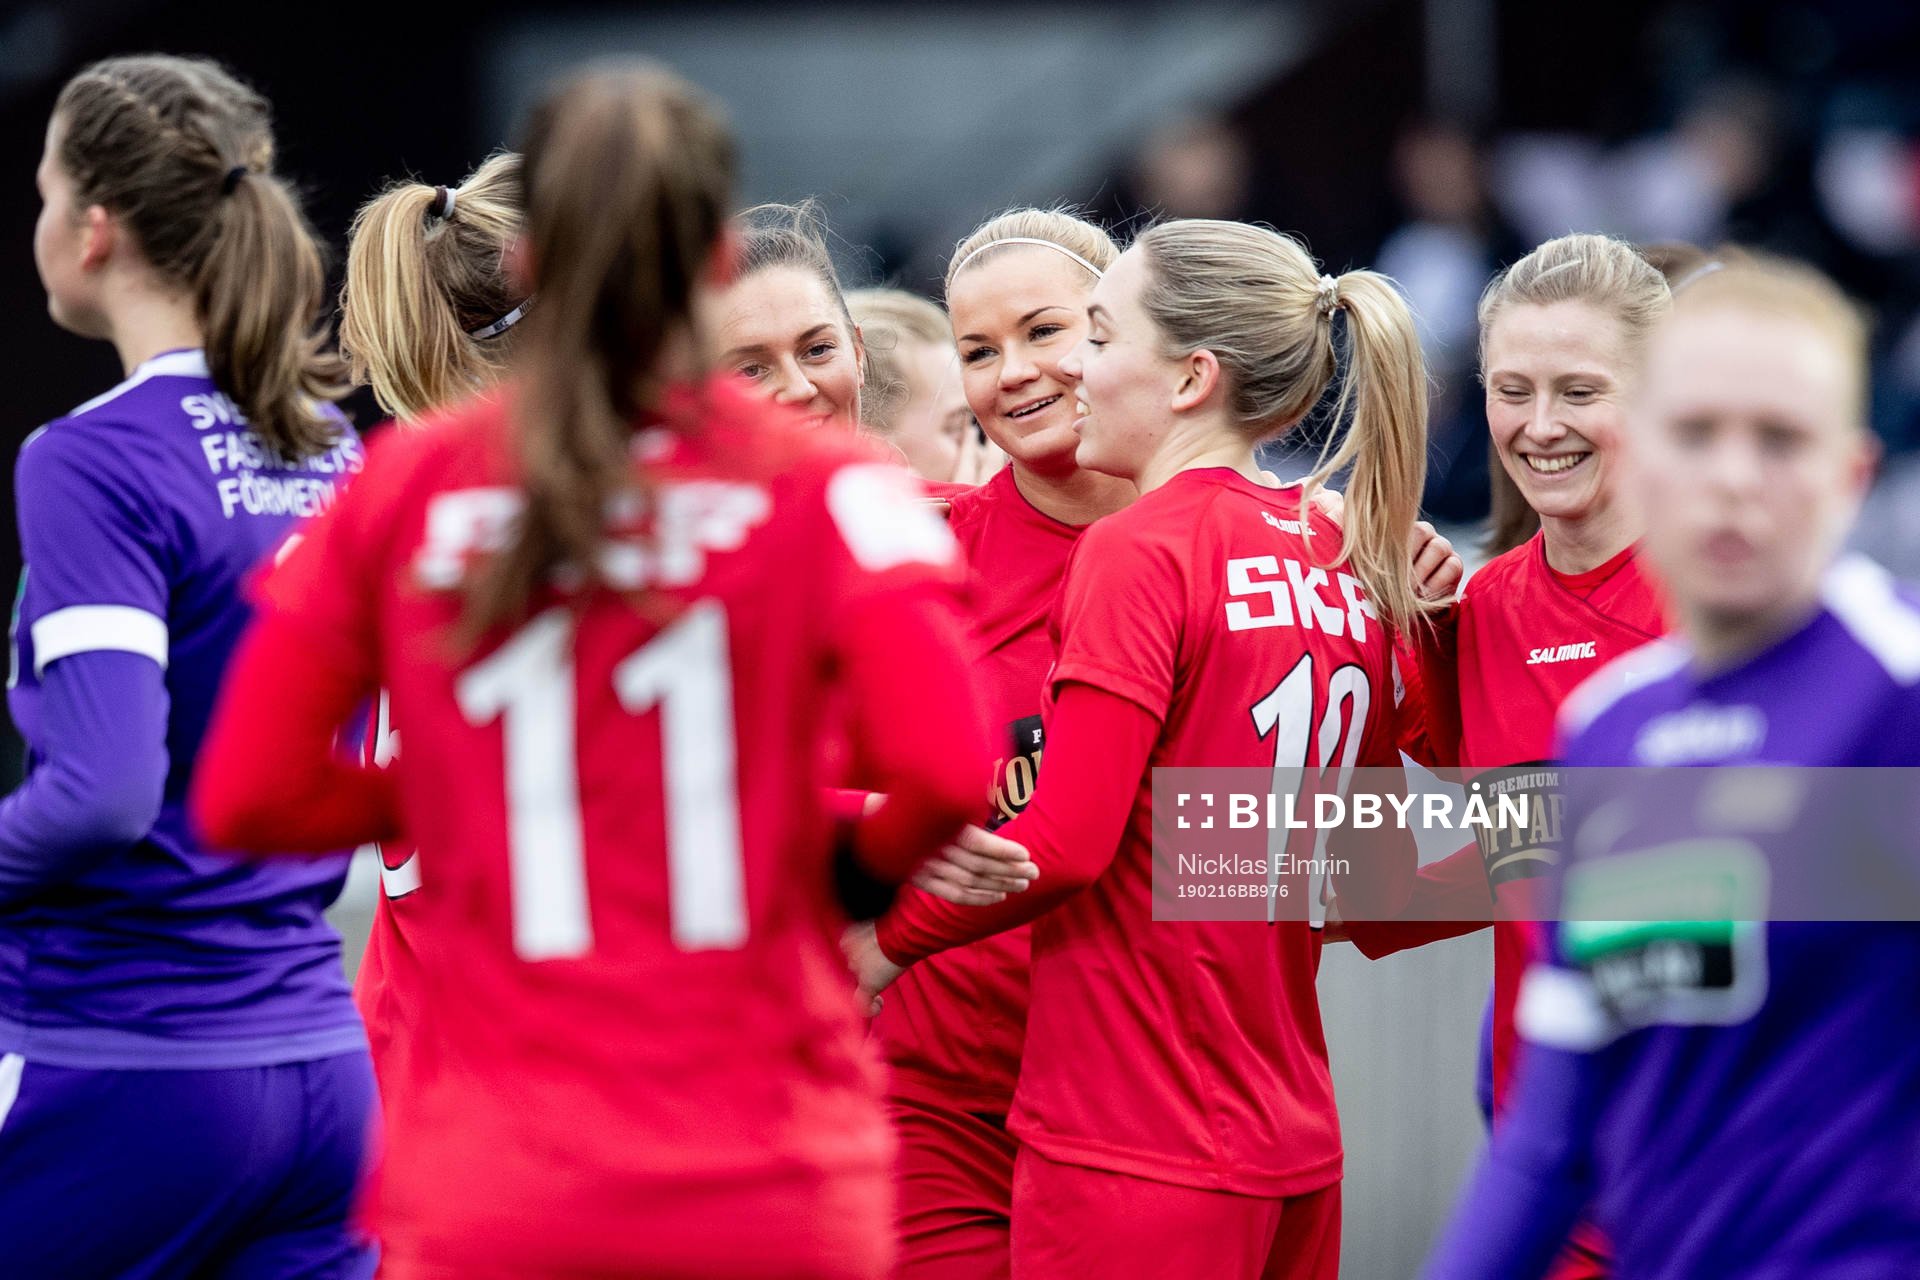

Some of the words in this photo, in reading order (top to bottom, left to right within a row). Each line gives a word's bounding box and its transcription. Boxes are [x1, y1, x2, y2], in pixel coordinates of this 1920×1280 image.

[1526, 641, 1597, 664] SALMING
[456, 598, 748, 960] 11
[1489, 773, 1559, 798] PREMIUM
